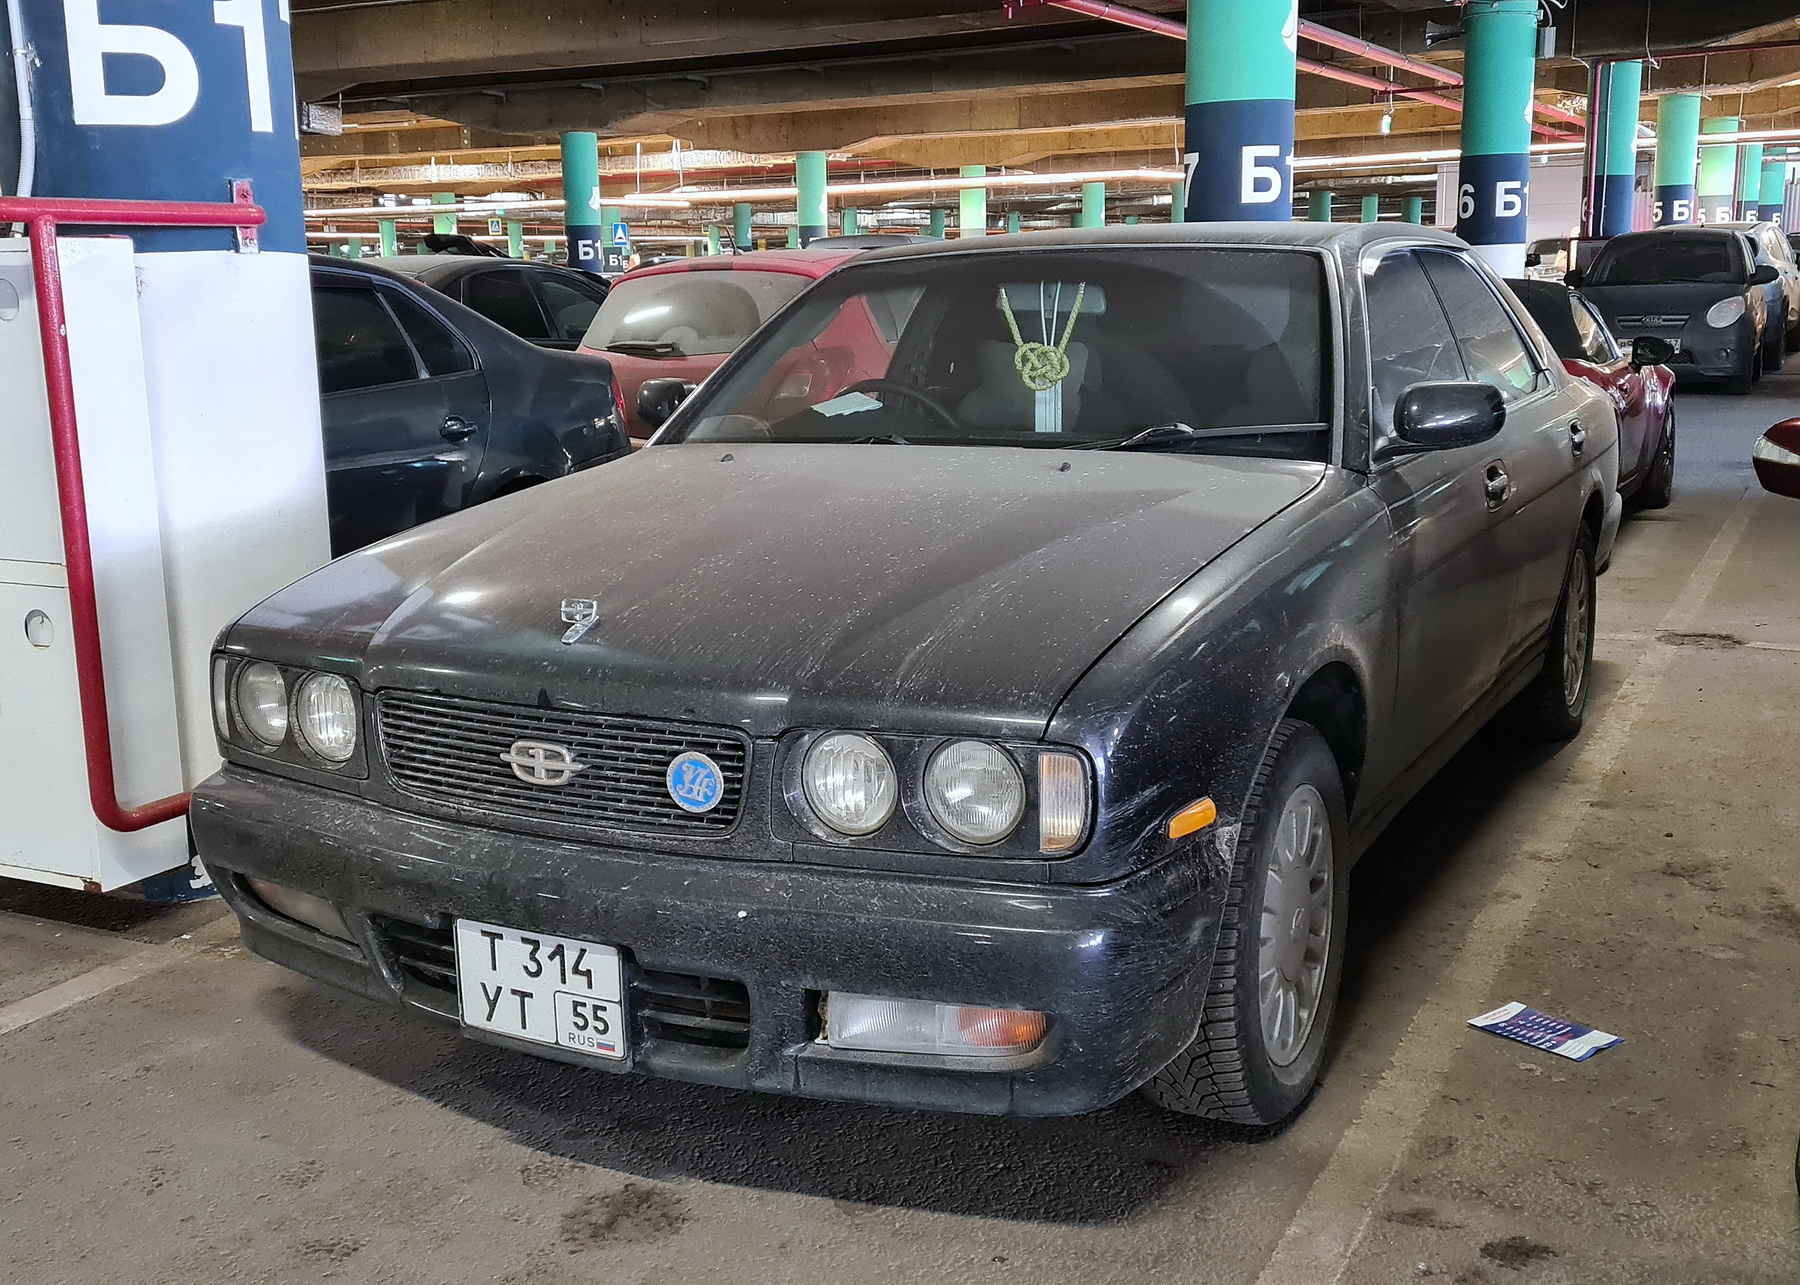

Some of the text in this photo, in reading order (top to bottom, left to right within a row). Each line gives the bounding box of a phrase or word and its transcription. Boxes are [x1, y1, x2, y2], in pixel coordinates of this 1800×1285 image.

[62, 0, 298, 139] Б1
[1459, 183, 1475, 219] 6
[1652, 201, 1663, 222] 5
[578, 239, 602, 260] Б1
[609, 254, 622, 266] Б1
[480, 929, 593, 990] Т 314
[480, 981, 534, 1030] УТ
[572, 1000, 610, 1036] 55
[568, 1032, 595, 1048] RUS
